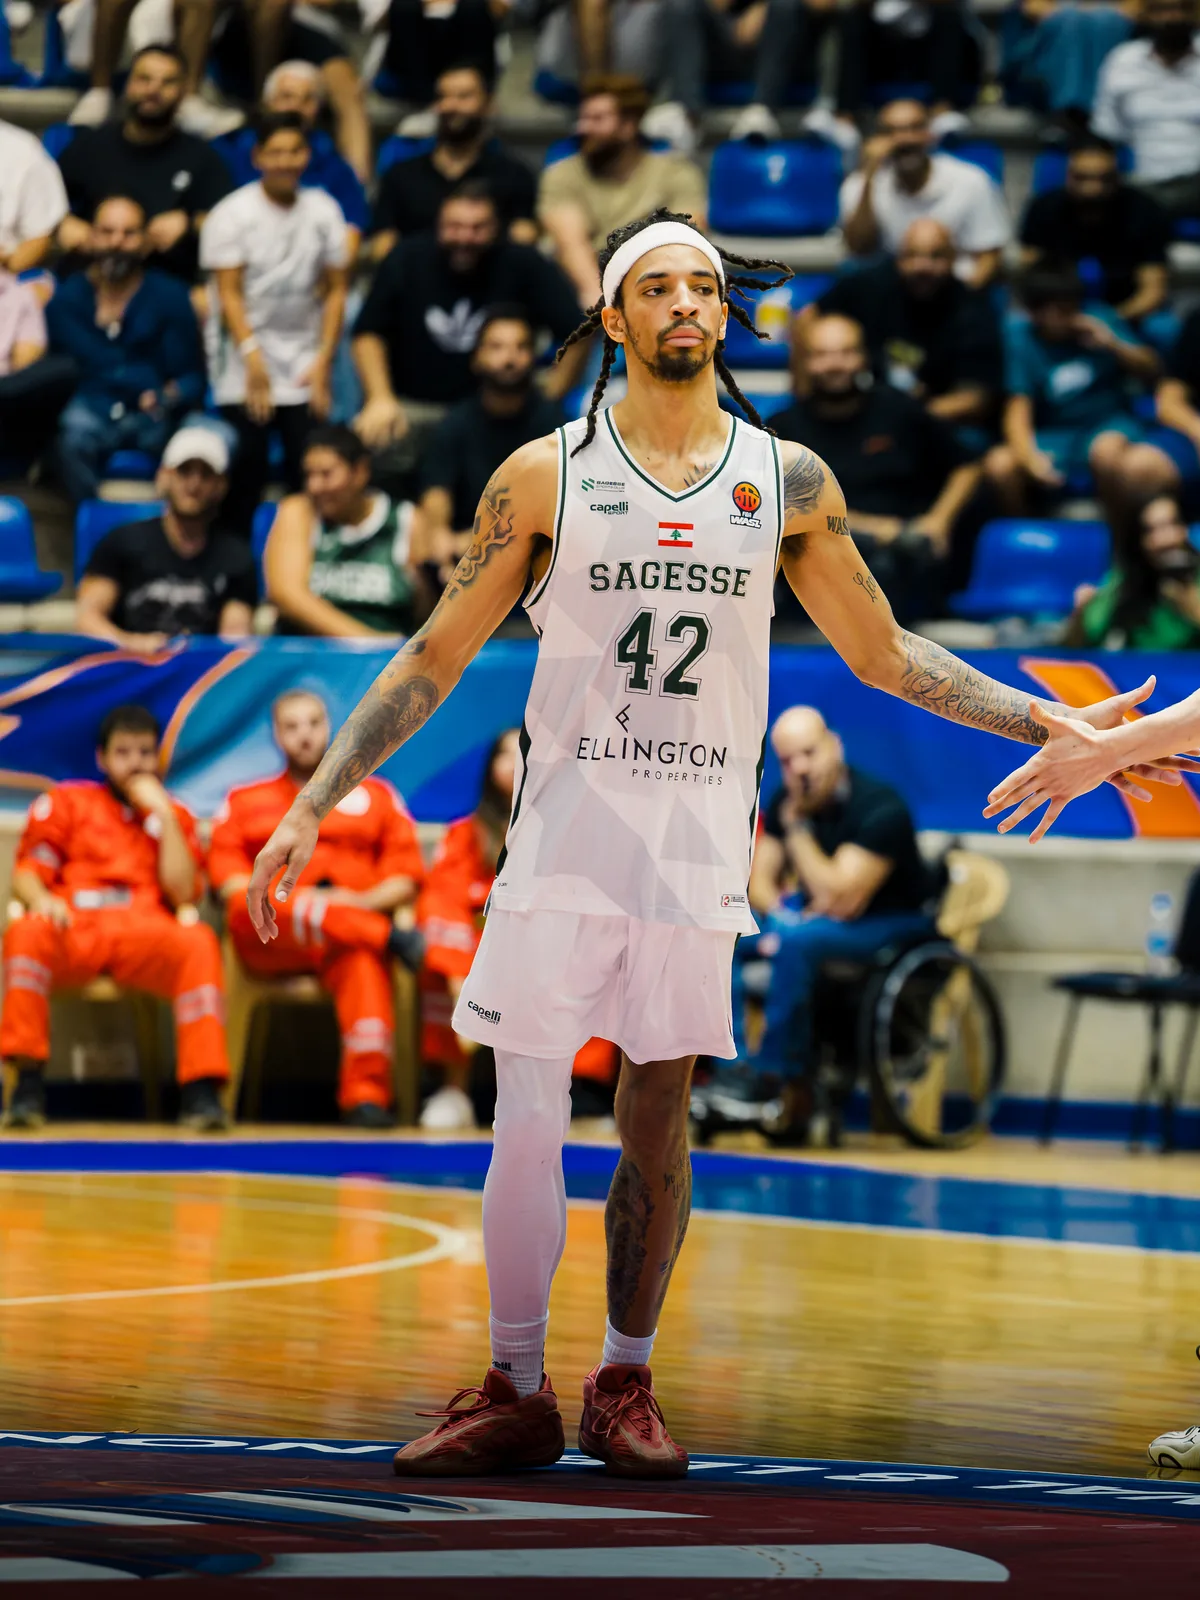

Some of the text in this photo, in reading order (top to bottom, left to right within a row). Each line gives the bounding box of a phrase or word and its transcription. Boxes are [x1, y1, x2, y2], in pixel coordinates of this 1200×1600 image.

[590, 501, 629, 514] capelli
[730, 515, 761, 529] WASL
[589, 560, 751, 597] SAGESSE
[614, 607, 713, 701] 42
[576, 737, 728, 768] ELLINGTON
[631, 769, 723, 785] PROPERTIES
[467, 1000, 501, 1022] capelli
[824, 1471, 959, 1483] 8
